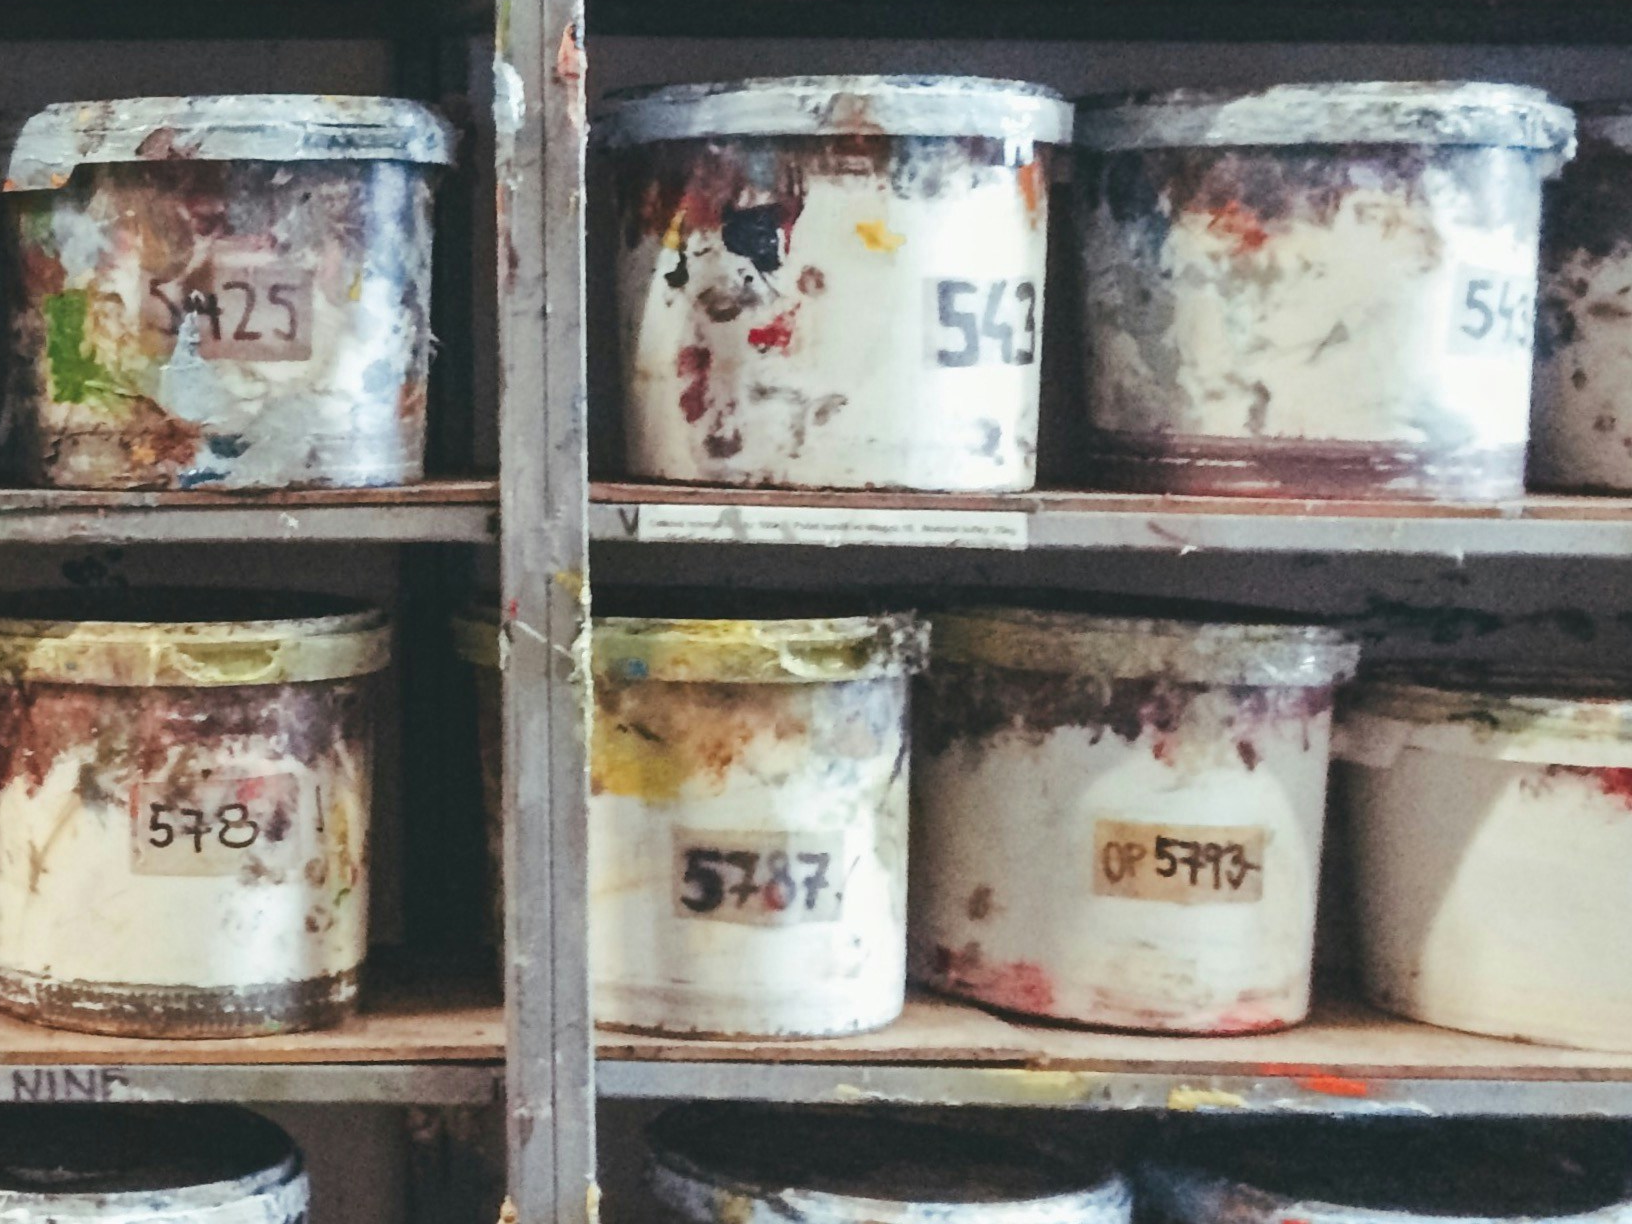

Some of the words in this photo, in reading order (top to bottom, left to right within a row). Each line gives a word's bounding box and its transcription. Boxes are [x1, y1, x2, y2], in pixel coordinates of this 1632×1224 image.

[148, 278, 298, 343] 5425
[936, 280, 1036, 366] 543
[150, 804, 258, 852] 578
[1103, 842, 1146, 882] OP
[1155, 836, 1260, 891] 5793
